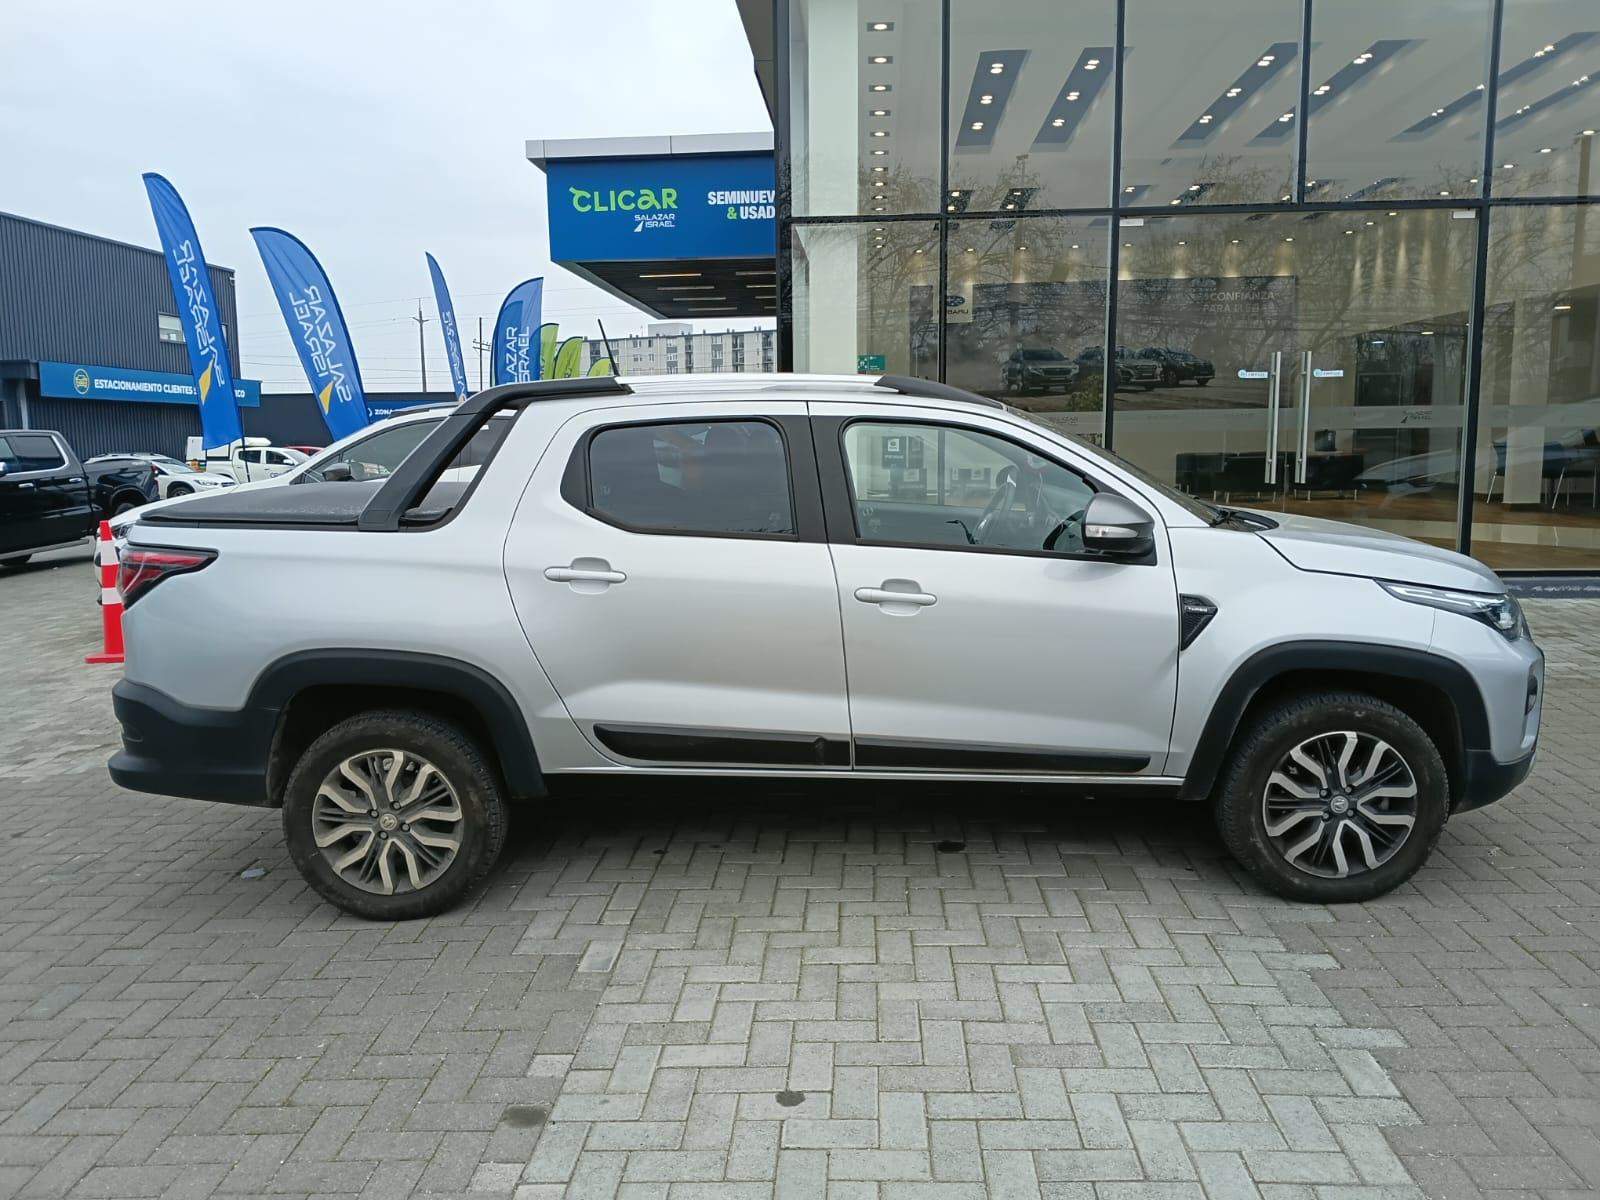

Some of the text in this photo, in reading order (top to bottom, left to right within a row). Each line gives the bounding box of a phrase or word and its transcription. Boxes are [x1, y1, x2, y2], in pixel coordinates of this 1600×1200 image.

[569, 187, 678, 213] CLICAR
[707, 190, 776, 206] SEMINUEV
[634, 213, 676, 221] SALAZAR
[726, 205, 776, 220] & USAD
[505, 326, 518, 385] LAZAR
[518, 326, 531, 384] SRAEL
[94, 378, 163, 393] ESTACIONAMIENTO
[163, 384, 193, 395] CLIENTES
